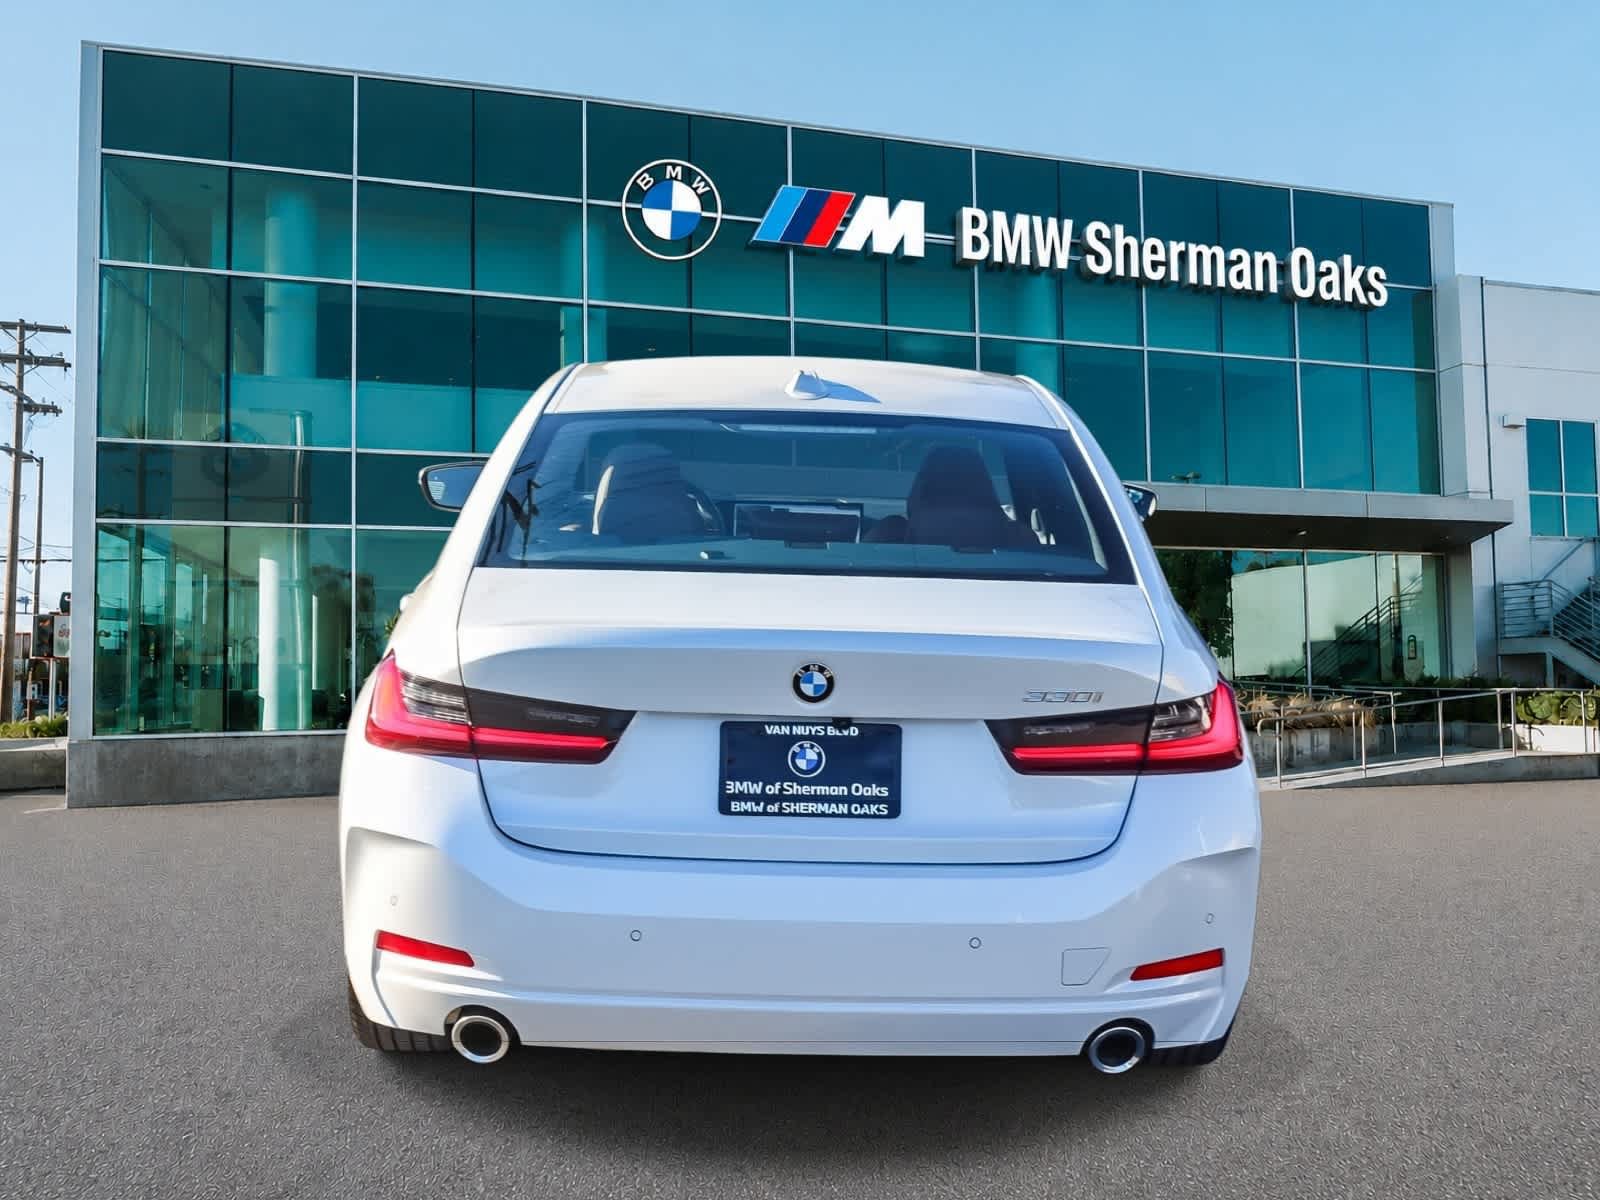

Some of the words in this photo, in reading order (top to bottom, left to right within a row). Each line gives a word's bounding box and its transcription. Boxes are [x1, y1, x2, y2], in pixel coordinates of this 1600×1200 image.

[636, 165, 711, 194] BMW
[960, 206, 1073, 270] BMW
[1085, 221, 1278, 293] Sherman
[1290, 247, 1388, 307] Oaks
[765, 724, 790, 736] VAN
[792, 725, 825, 736] NUYS
[765, 782, 781, 795] of
[783, 782, 848, 796] Sherman
[851, 783, 889, 797] Oaks
[730, 801, 764, 813] BMW
[766, 803, 780, 813] of
[781, 802, 848, 815] SHERMAN
[850, 803, 889, 815] OAKS
